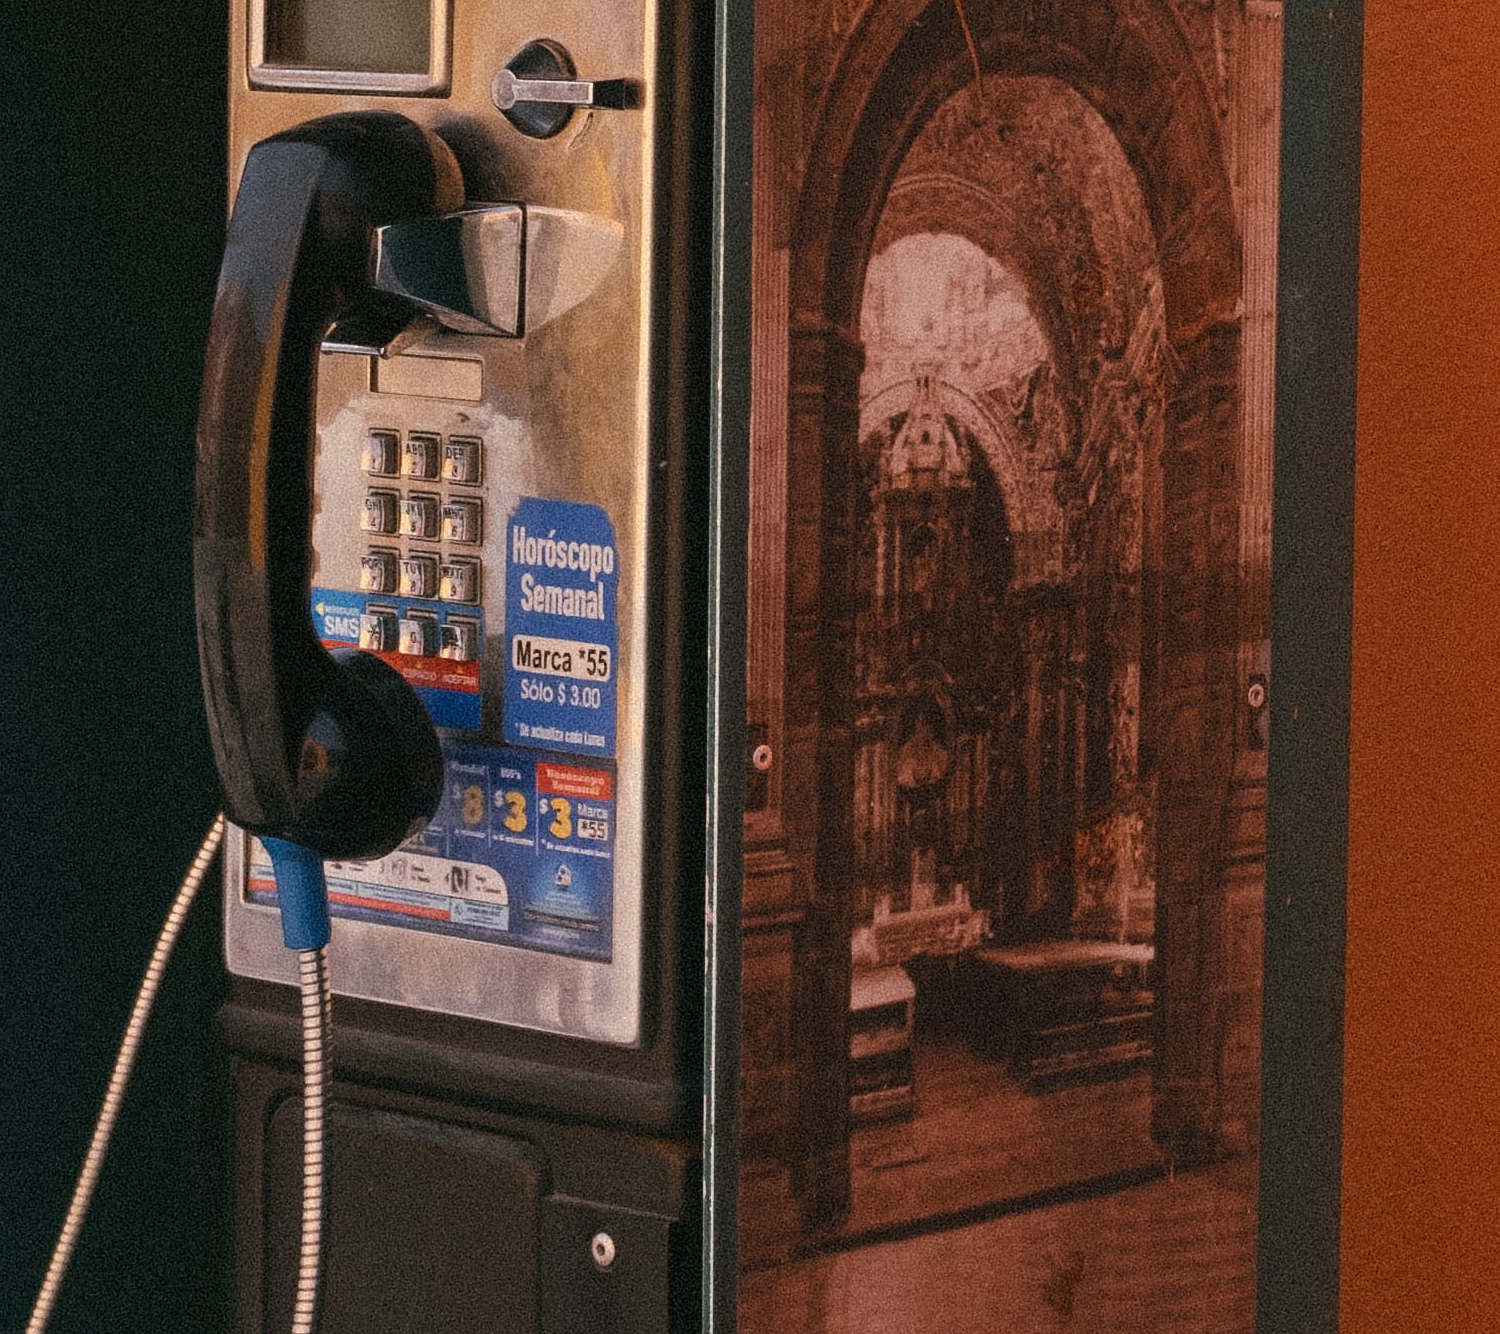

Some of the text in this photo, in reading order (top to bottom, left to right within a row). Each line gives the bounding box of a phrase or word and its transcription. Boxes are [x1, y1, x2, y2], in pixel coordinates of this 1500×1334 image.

[512, 525, 614, 582] Horóscopo
[520, 573, 605, 621] Semanal
[324, 615, 360, 637] SMS
[516, 640, 572, 674] Marca
[520, 678, 601, 709] Sólo $ 3.00
